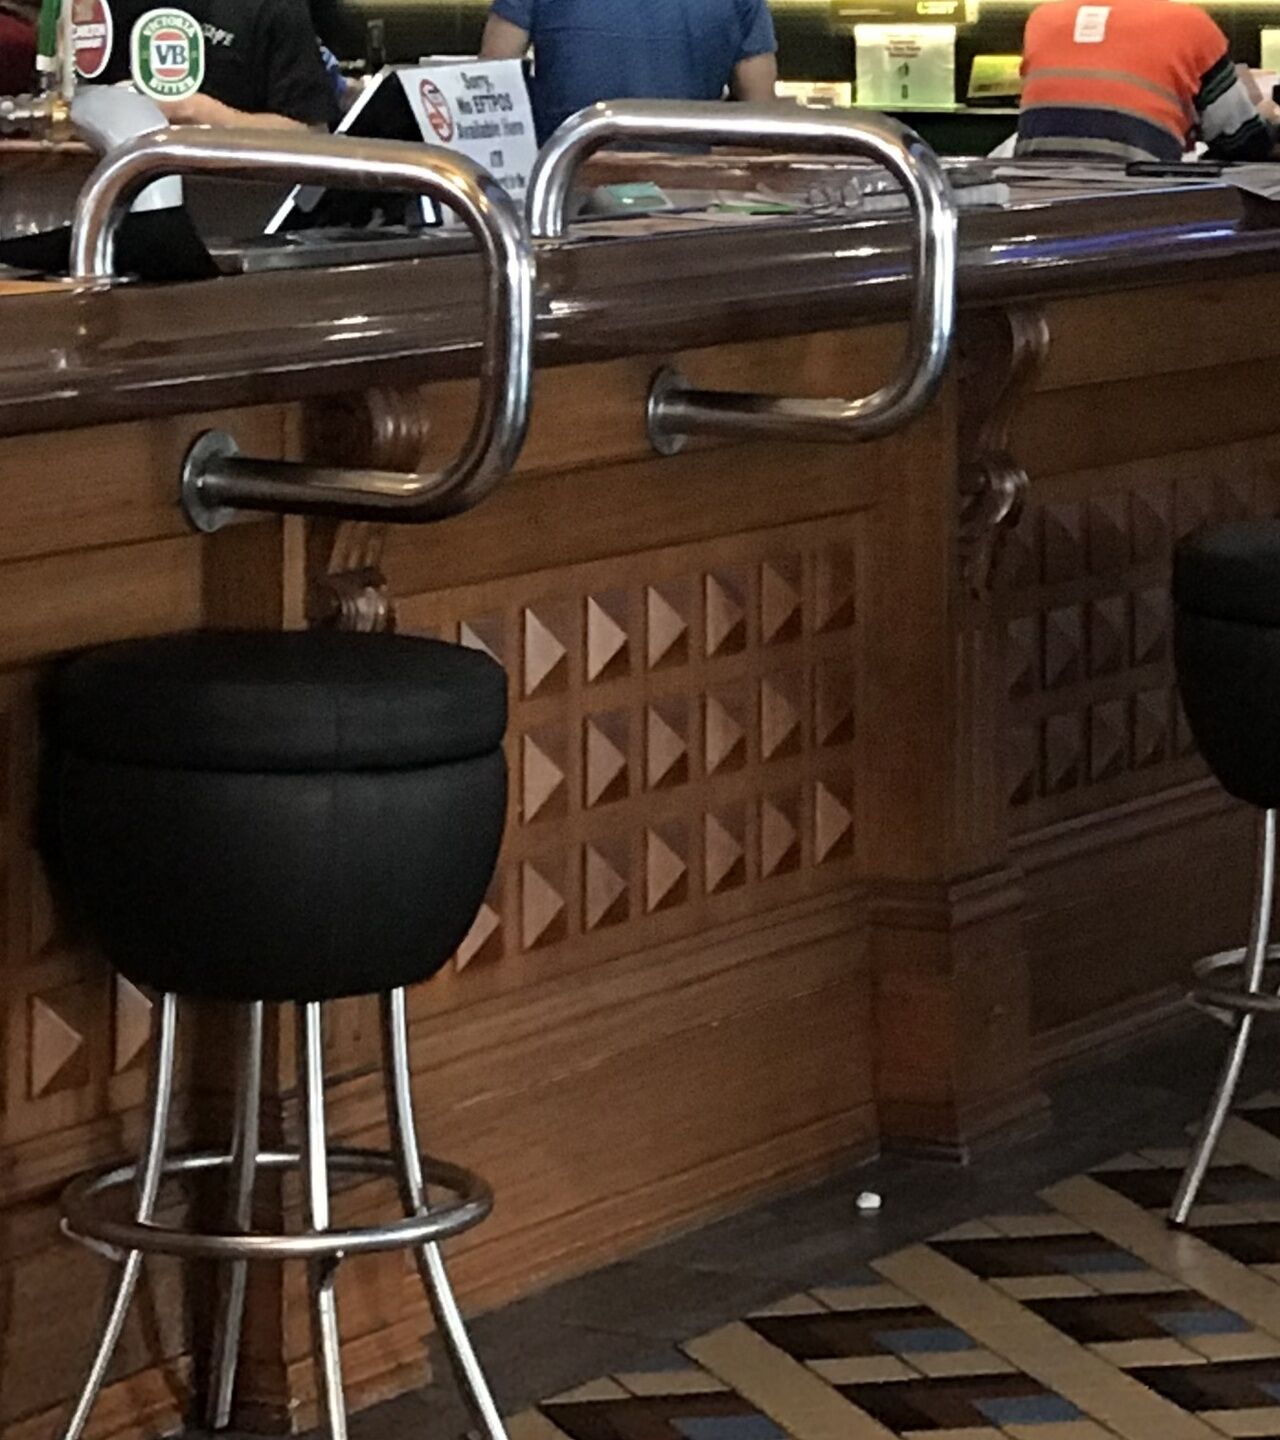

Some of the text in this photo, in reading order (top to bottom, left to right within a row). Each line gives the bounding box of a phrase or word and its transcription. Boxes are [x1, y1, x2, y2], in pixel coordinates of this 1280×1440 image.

[142, 16, 197, 39] VICTORIA
[155, 44, 188, 66] VB
[456, 92, 514, 115] No EFTPOS
